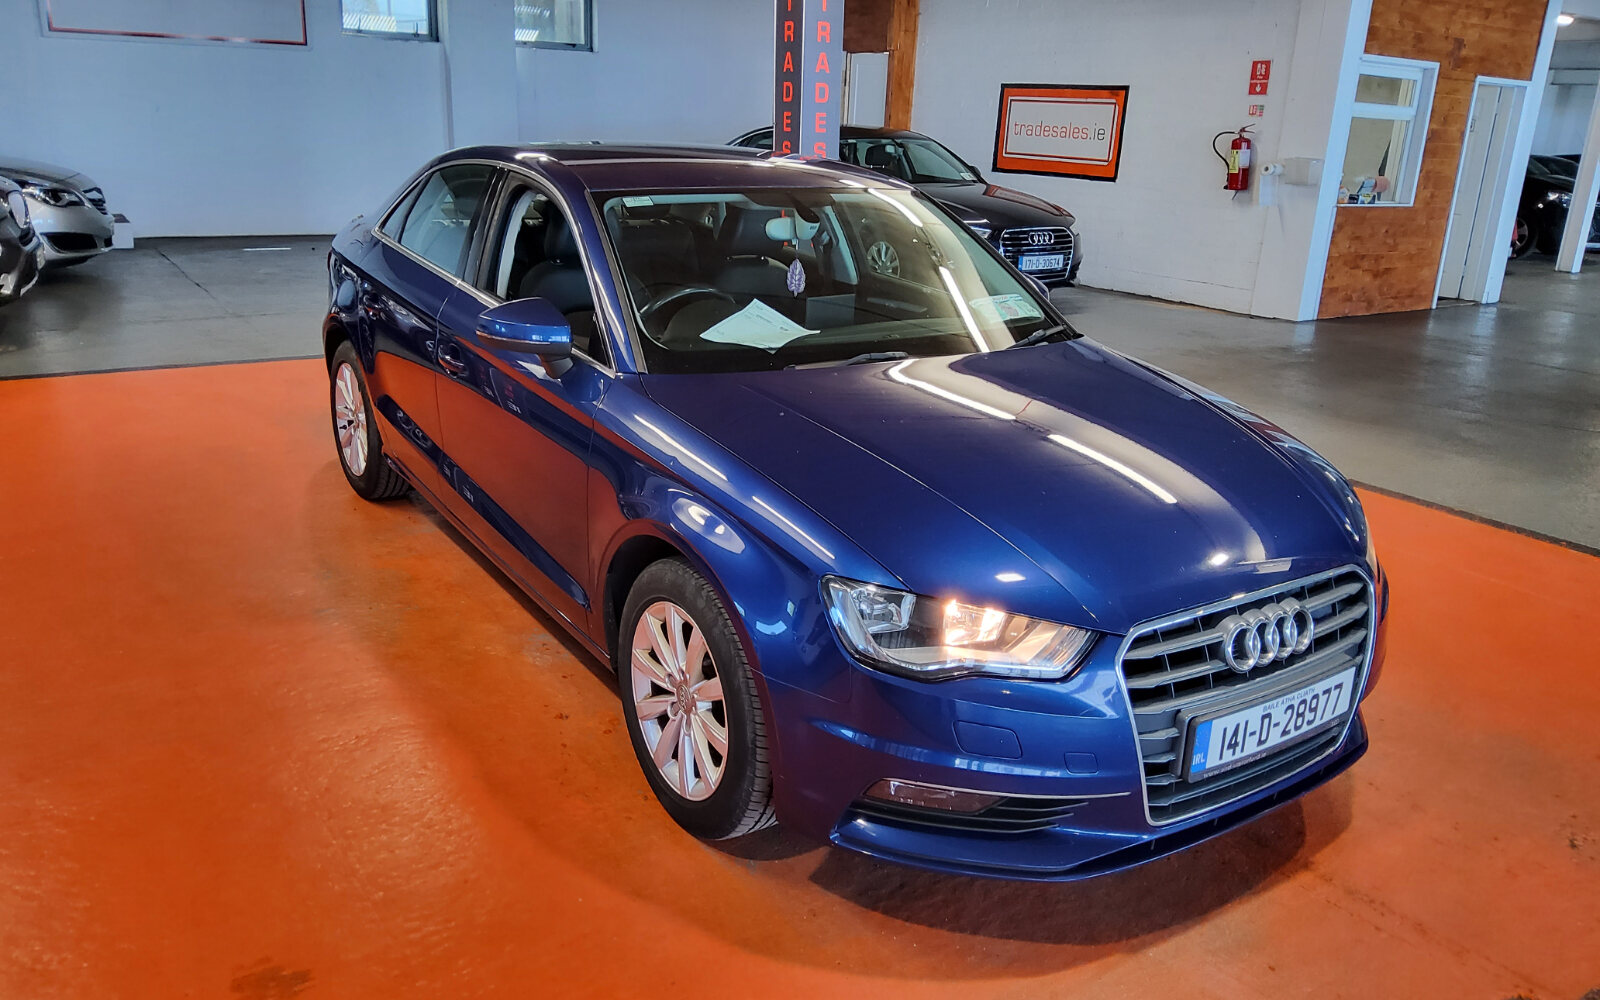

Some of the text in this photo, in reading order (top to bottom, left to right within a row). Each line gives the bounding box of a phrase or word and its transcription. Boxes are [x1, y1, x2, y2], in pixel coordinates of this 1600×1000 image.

[1014, 121, 1106, 141] tradesales.ie
[1219, 682, 1344, 761] 141-D-28977
[1192, 752, 1205, 766] IRL
